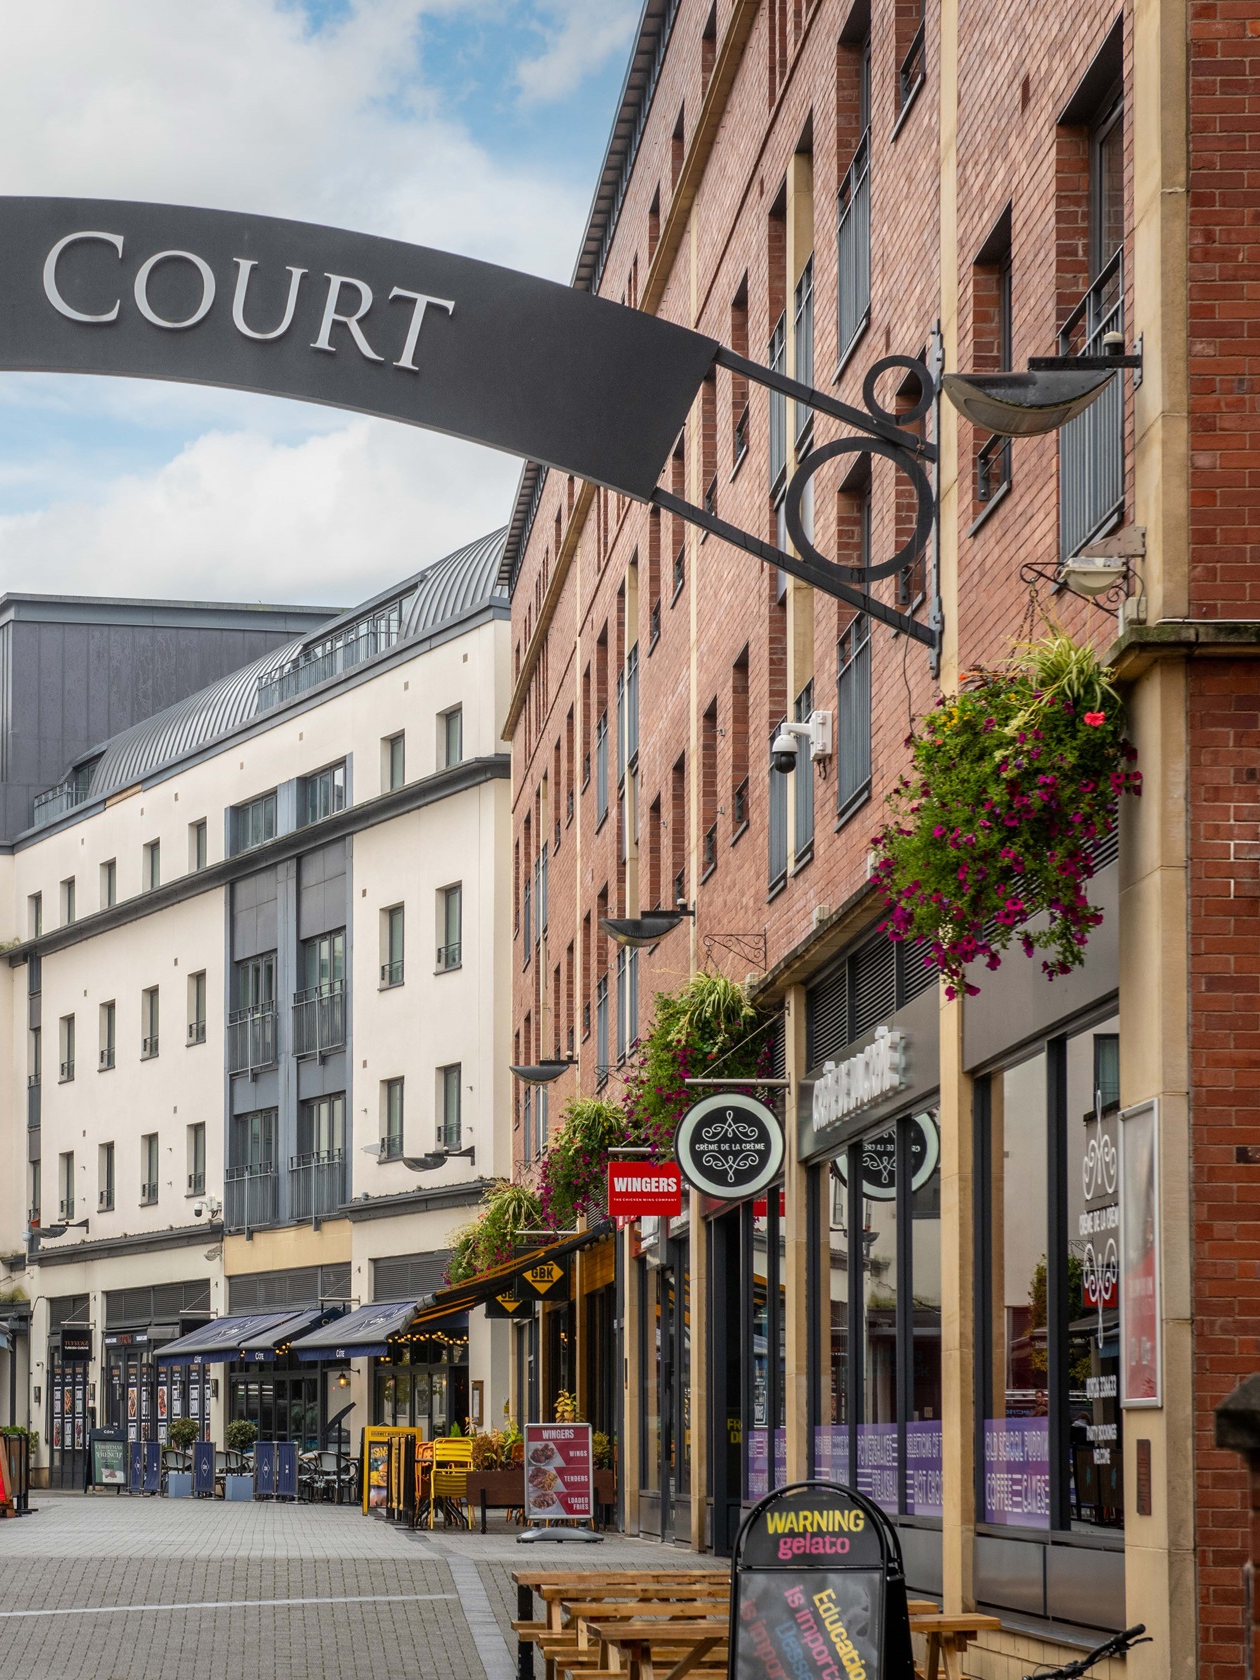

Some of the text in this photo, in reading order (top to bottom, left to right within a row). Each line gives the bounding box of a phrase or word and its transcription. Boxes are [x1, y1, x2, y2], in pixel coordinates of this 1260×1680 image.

[42, 230, 456, 371] COURT
[696, 1142, 718, 1151] CRÈME
[742, 1142, 766, 1150] CRÈME
[614, 1177, 677, 1192] WINGERS
[531, 1267, 554, 1279] GBK
[542, 1429, 574, 1439] WINGERS
[766, 1510, 865, 1534] WARNING
[778, 1532, 850, 1560] gelato
[795, 1608, 841, 1680] import
[813, 1588, 868, 1680] Educatio
